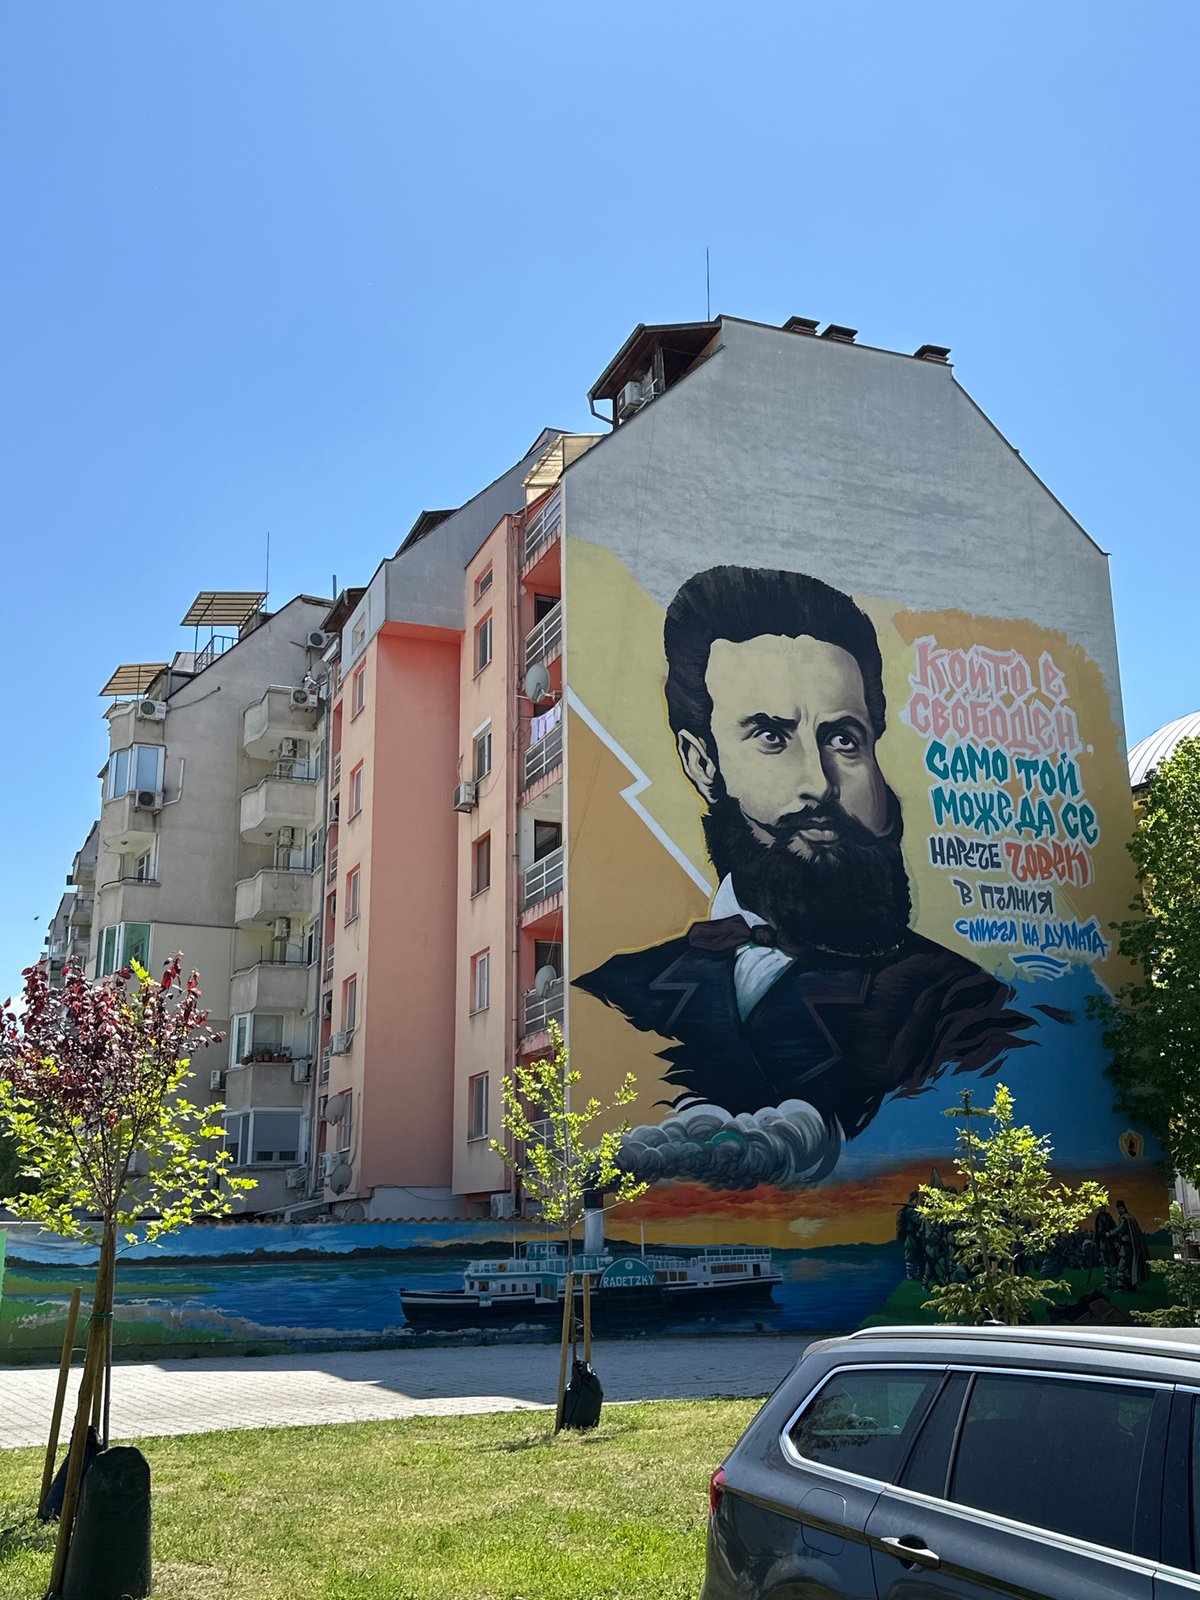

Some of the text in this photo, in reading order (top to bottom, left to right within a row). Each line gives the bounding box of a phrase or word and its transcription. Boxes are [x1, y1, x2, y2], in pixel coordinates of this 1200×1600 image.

[925, 740, 1080, 796] САМО ТОЙ
[1014, 796, 1057, 838] ДА
[953, 879, 1054, 915] В ПЪЛНИЯ
[1021, 921, 1040, 947] НА
[1039, 922, 1109, 958] ДУМАТА
[603, 1275, 655, 1288] RADETZKY
